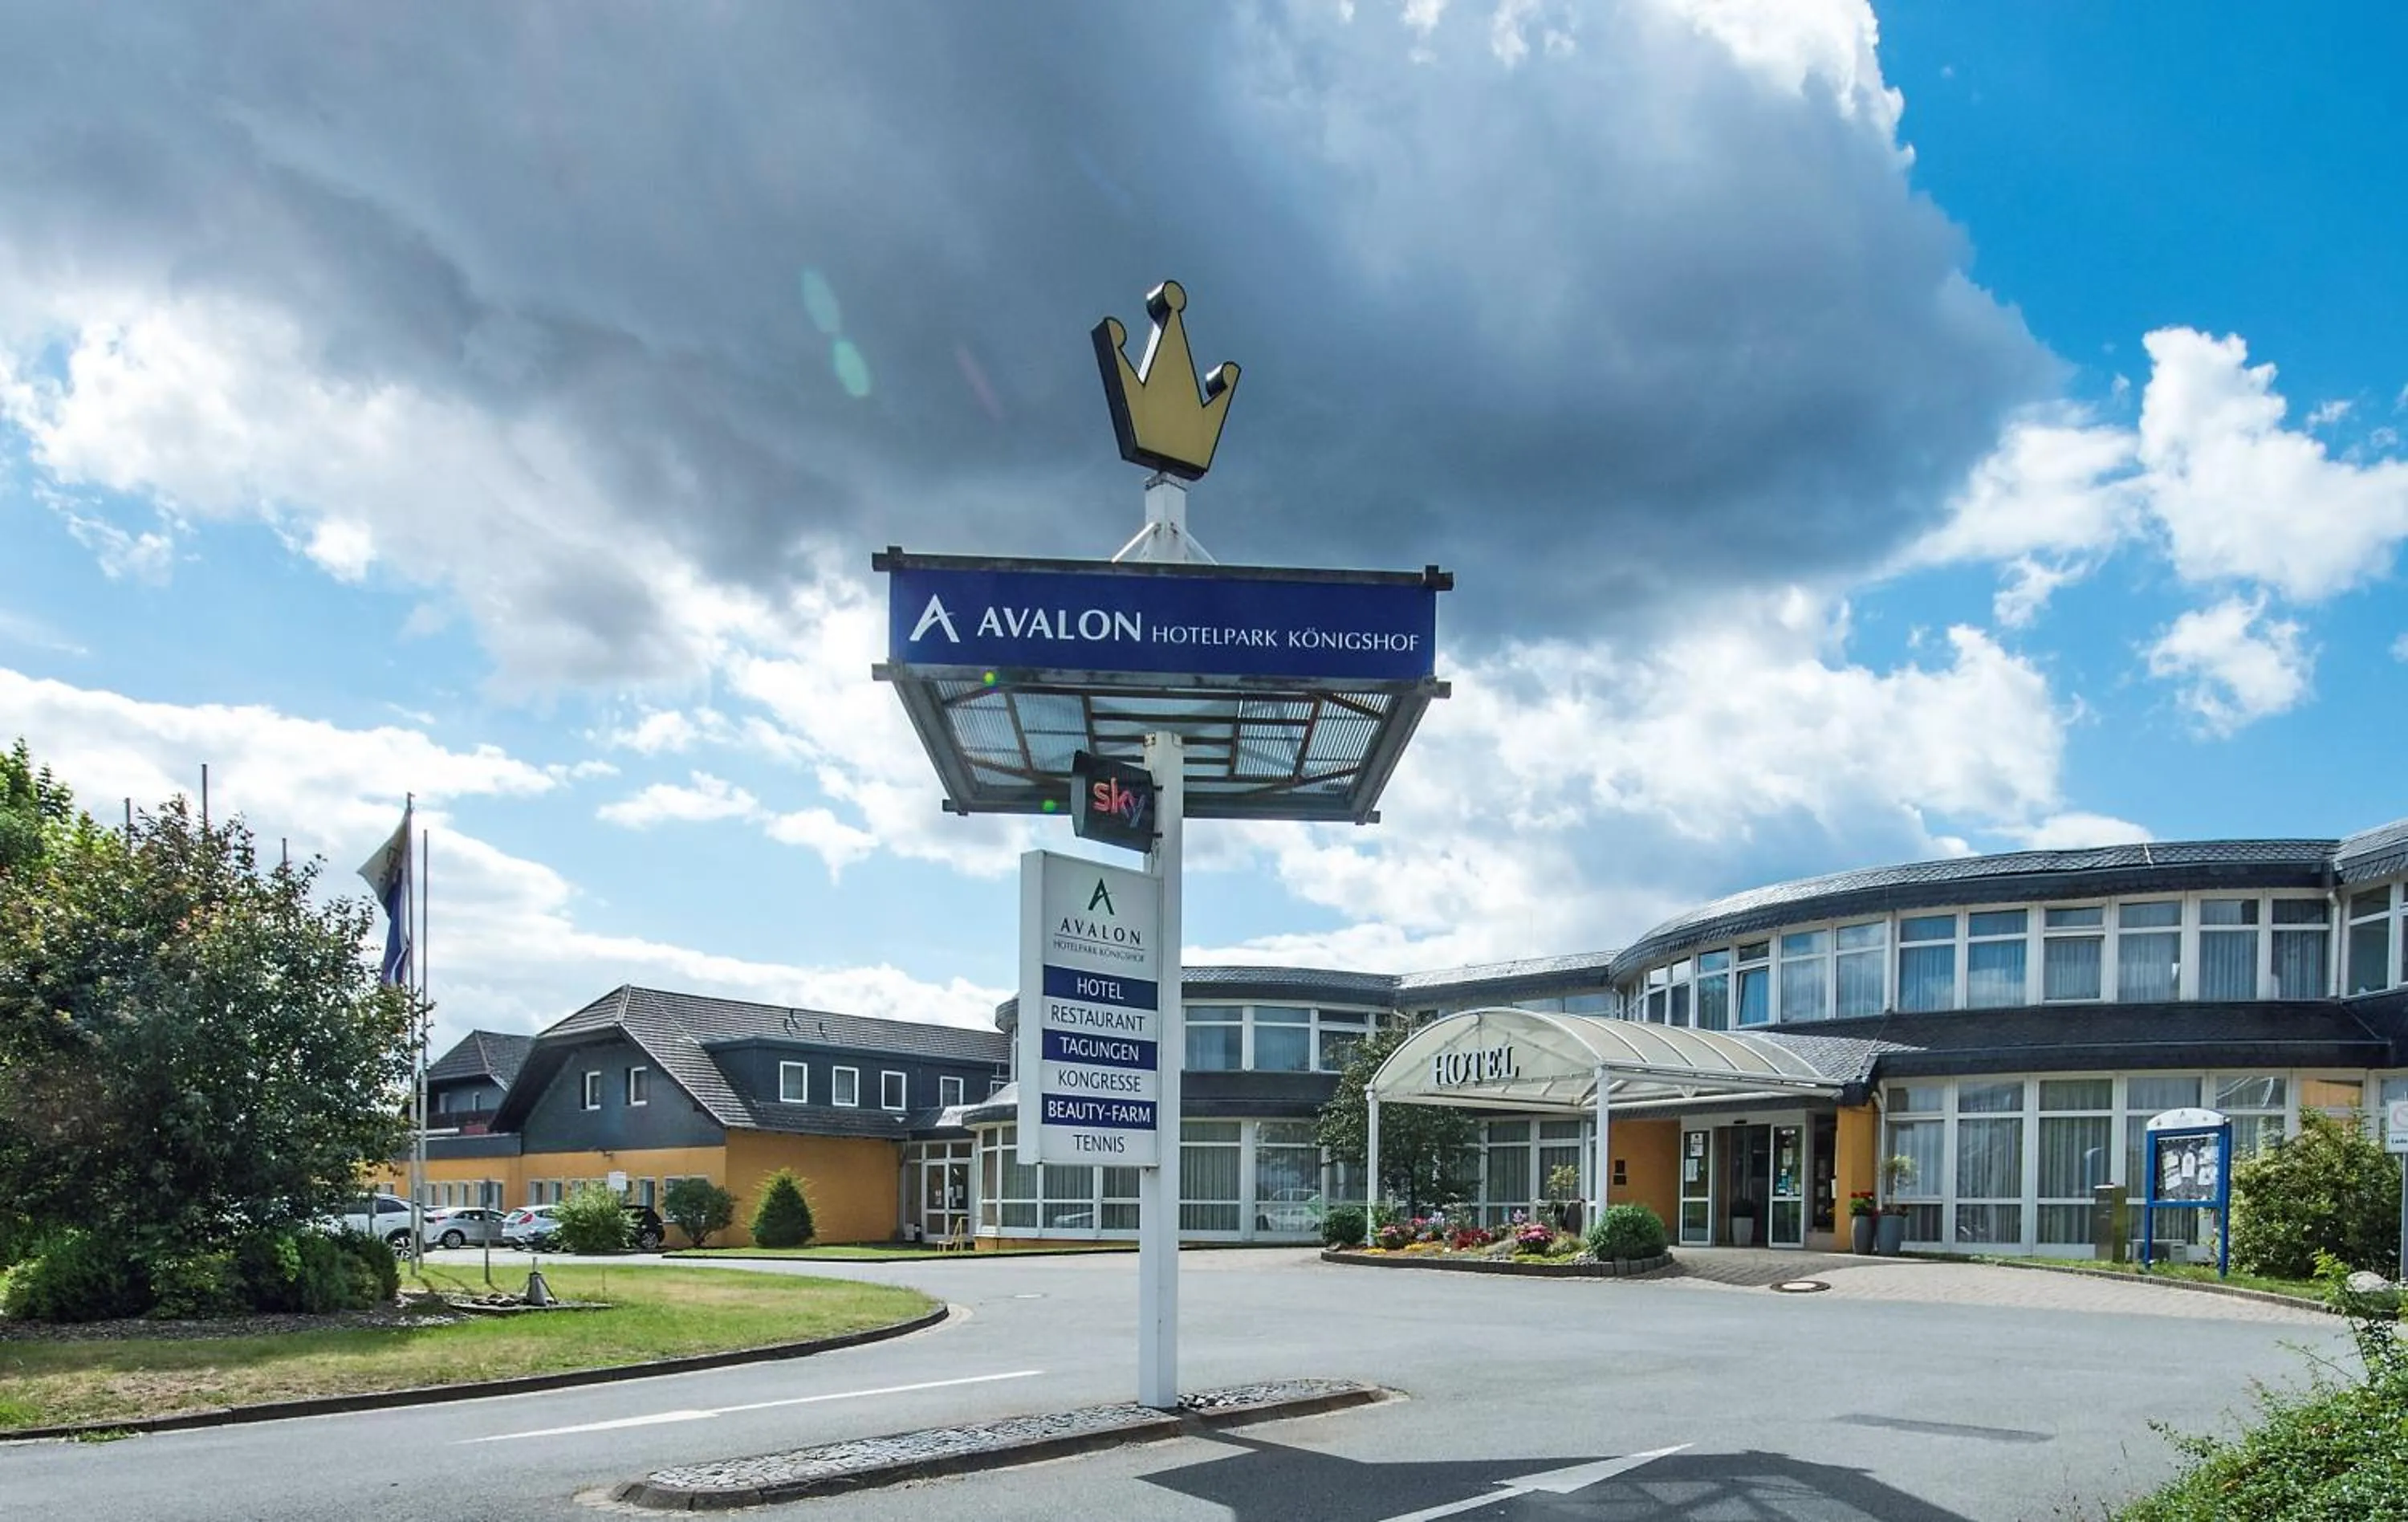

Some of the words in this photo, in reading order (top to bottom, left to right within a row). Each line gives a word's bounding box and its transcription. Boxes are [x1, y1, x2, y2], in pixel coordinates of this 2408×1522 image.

[977, 606, 1141, 641] AVALON
[1152, 625, 1278, 647] HOTELPARK
[1288, 627, 1419, 651] KÖNIGSHOF
[1093, 777, 1145, 828] sky
[1060, 918, 1141, 945] AVALON
[1077, 976, 1124, 999] HOTEL
[1051, 1004, 1145, 1032] RESTAURANT
[1060, 1036, 1139, 1060] TAGUNGEN
[1433, 1046, 1519, 1085] HOTEL
[1058, 1069, 1141, 1092] KONGRESSE
[1047, 1101, 1150, 1122] BEAUTY-FARM
[1073, 1134, 1125, 1153] TENNIS
